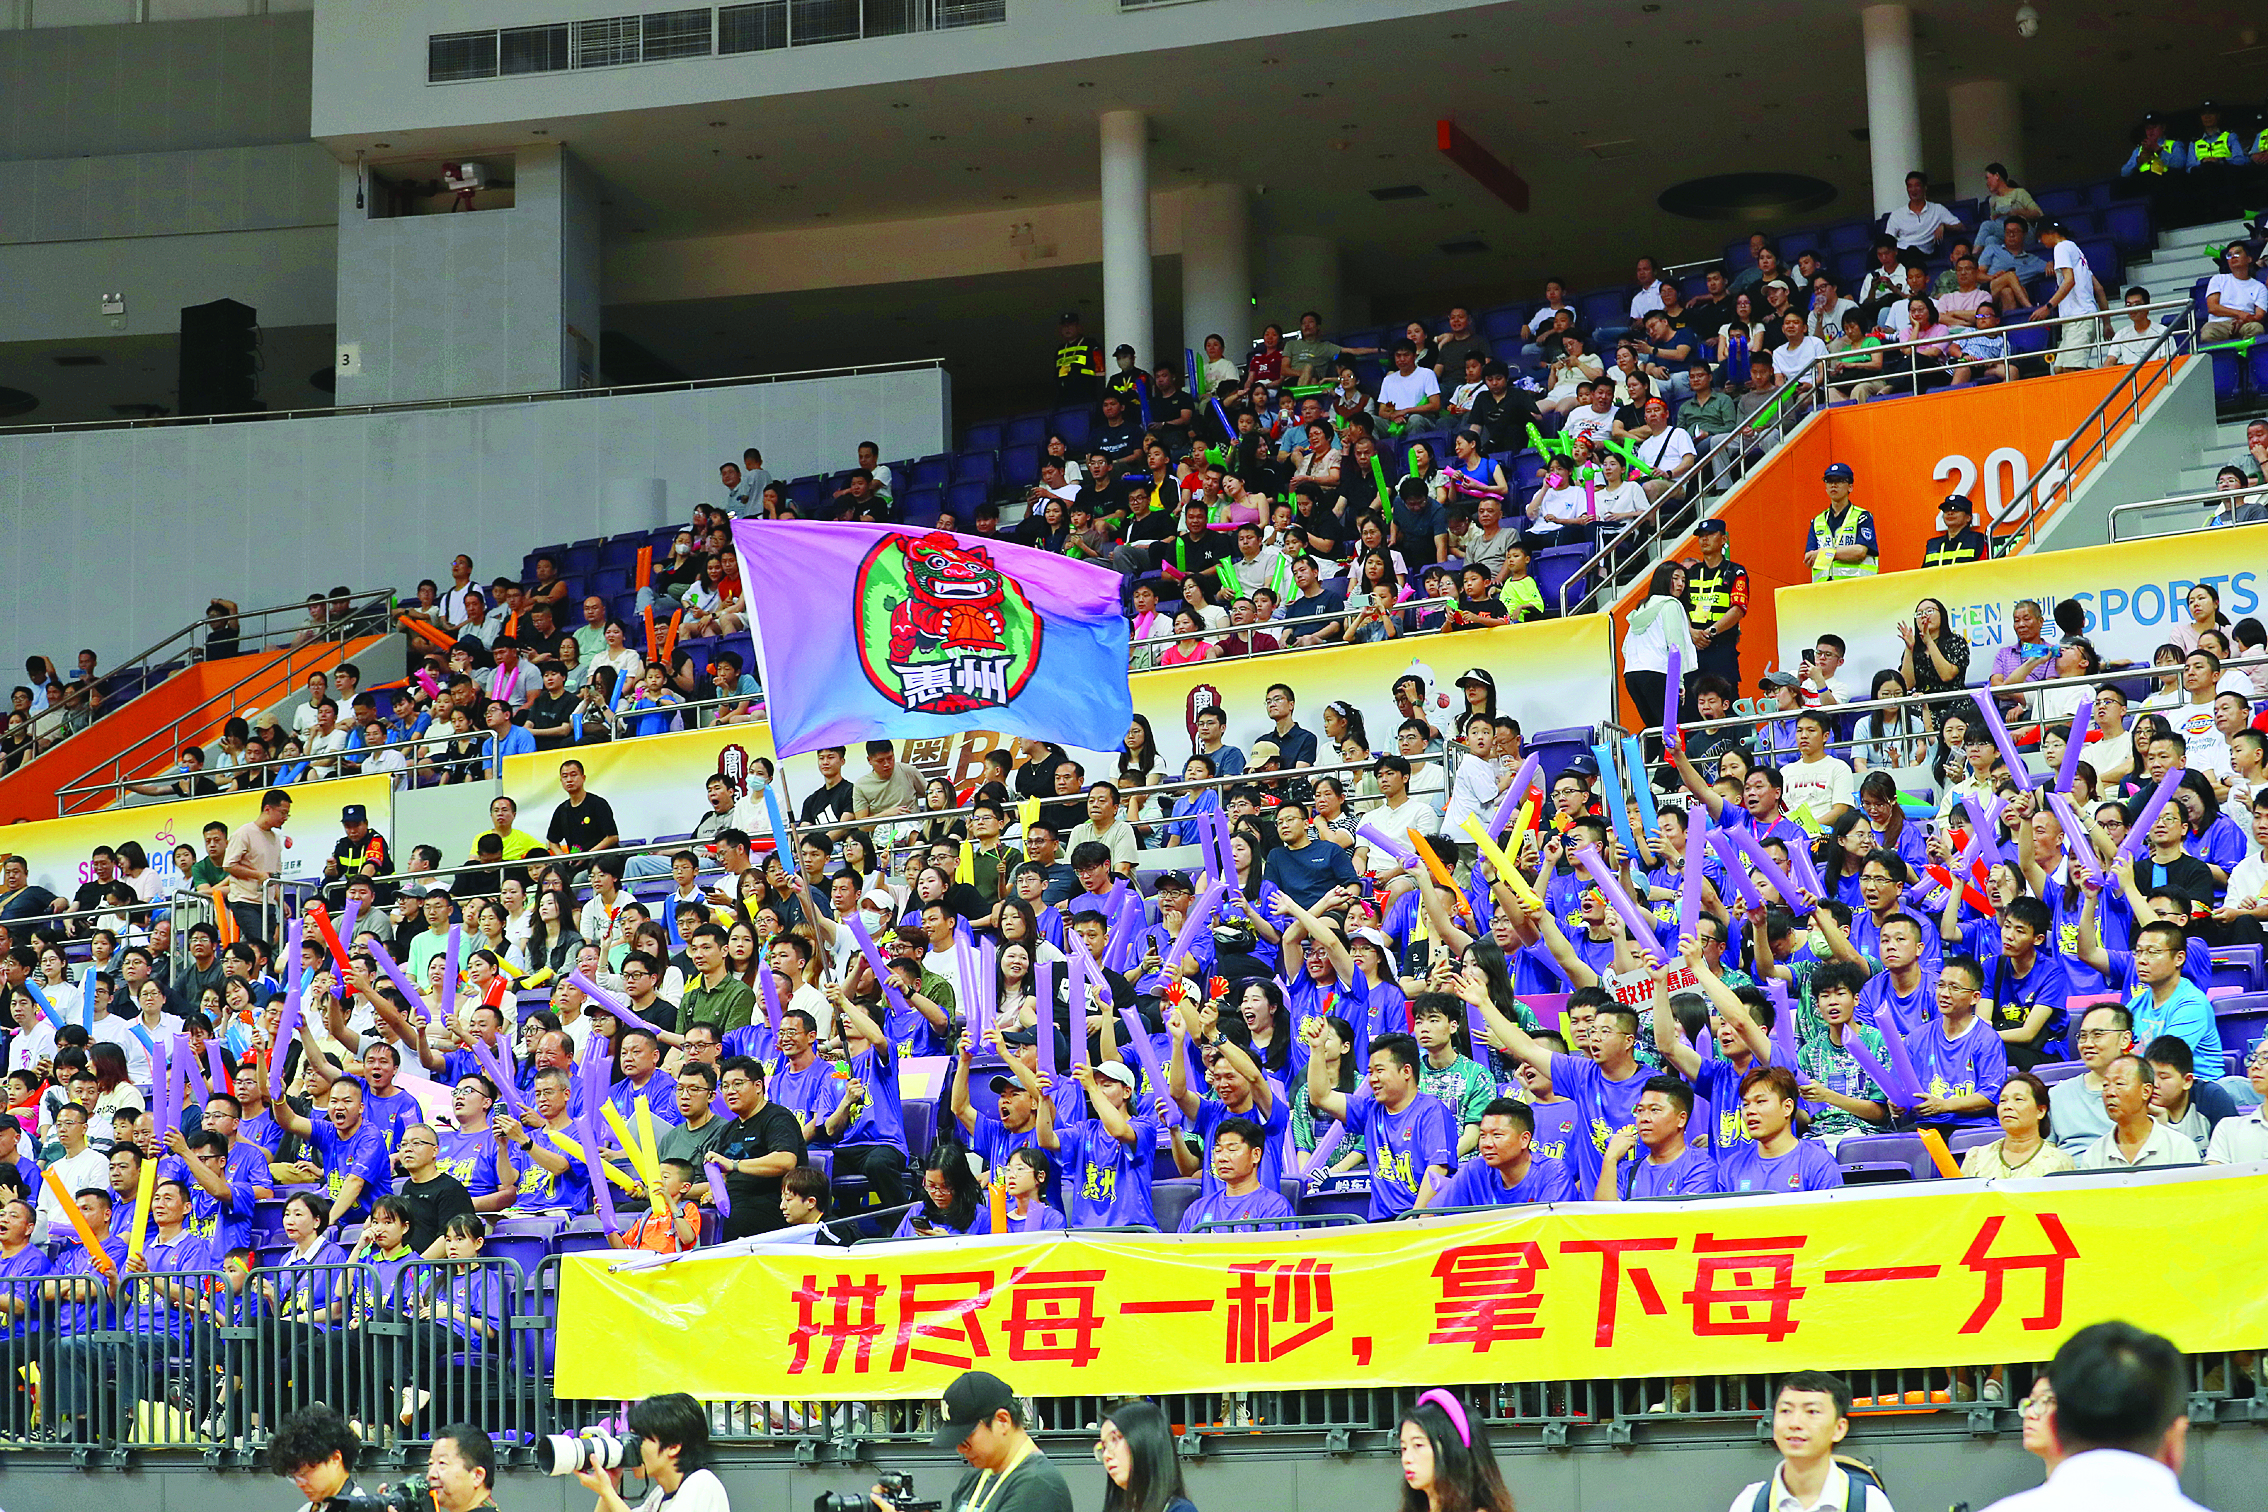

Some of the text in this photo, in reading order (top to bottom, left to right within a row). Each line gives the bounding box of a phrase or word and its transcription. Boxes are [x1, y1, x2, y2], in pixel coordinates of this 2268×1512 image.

[342, 353, 350, 366] 3
[1933, 439, 2077, 532] 206
[1951, 602, 2002, 628] HEN
[2070, 571, 2259, 634] SPORTS
[891, 658, 1012, 708] 惠州
[1615, 966, 1700, 1006] 敢拼惠赢
[511, 1163, 556, 1200] 惠州
[1080, 1161, 1116, 1205] 惠州
[1374, 1142, 1418, 1195] 惠州
[786, 1212, 2081, 1375] 拼尽每一秒，拿下每一分
